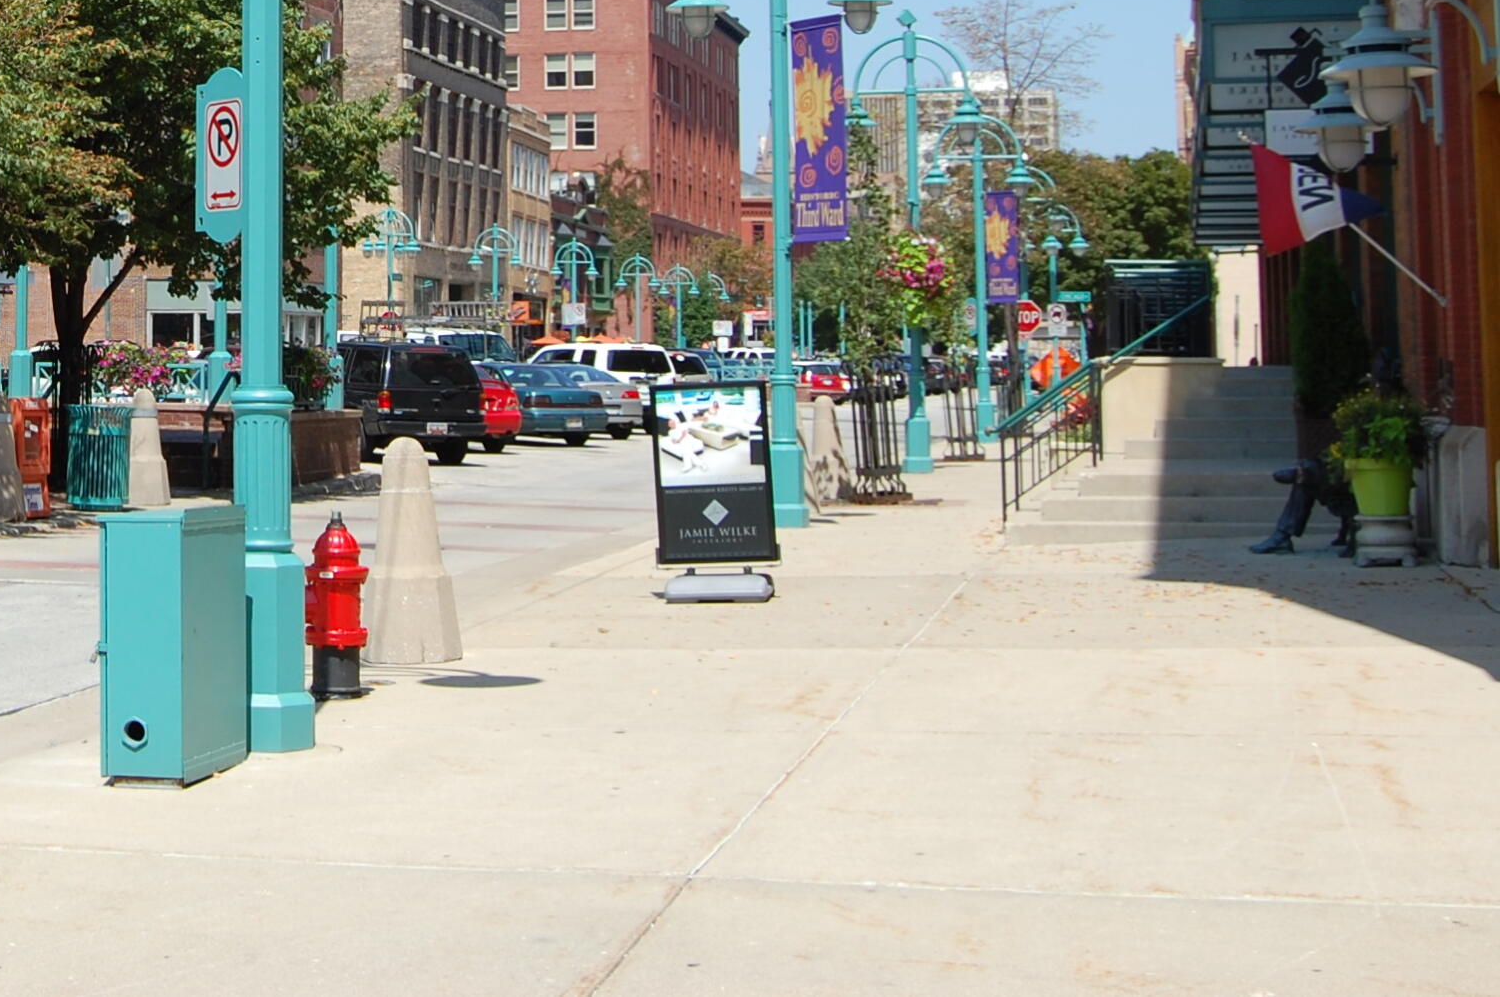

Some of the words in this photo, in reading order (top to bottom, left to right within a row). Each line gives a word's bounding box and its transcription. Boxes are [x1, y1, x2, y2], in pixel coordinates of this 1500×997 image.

[796, 201, 820, 228] Third
[821, 200, 845, 227] Ward
[1019, 310, 1039, 324] TOP
[679, 528, 715, 540] JAMIE
[719, 526, 757, 537] WILKE
